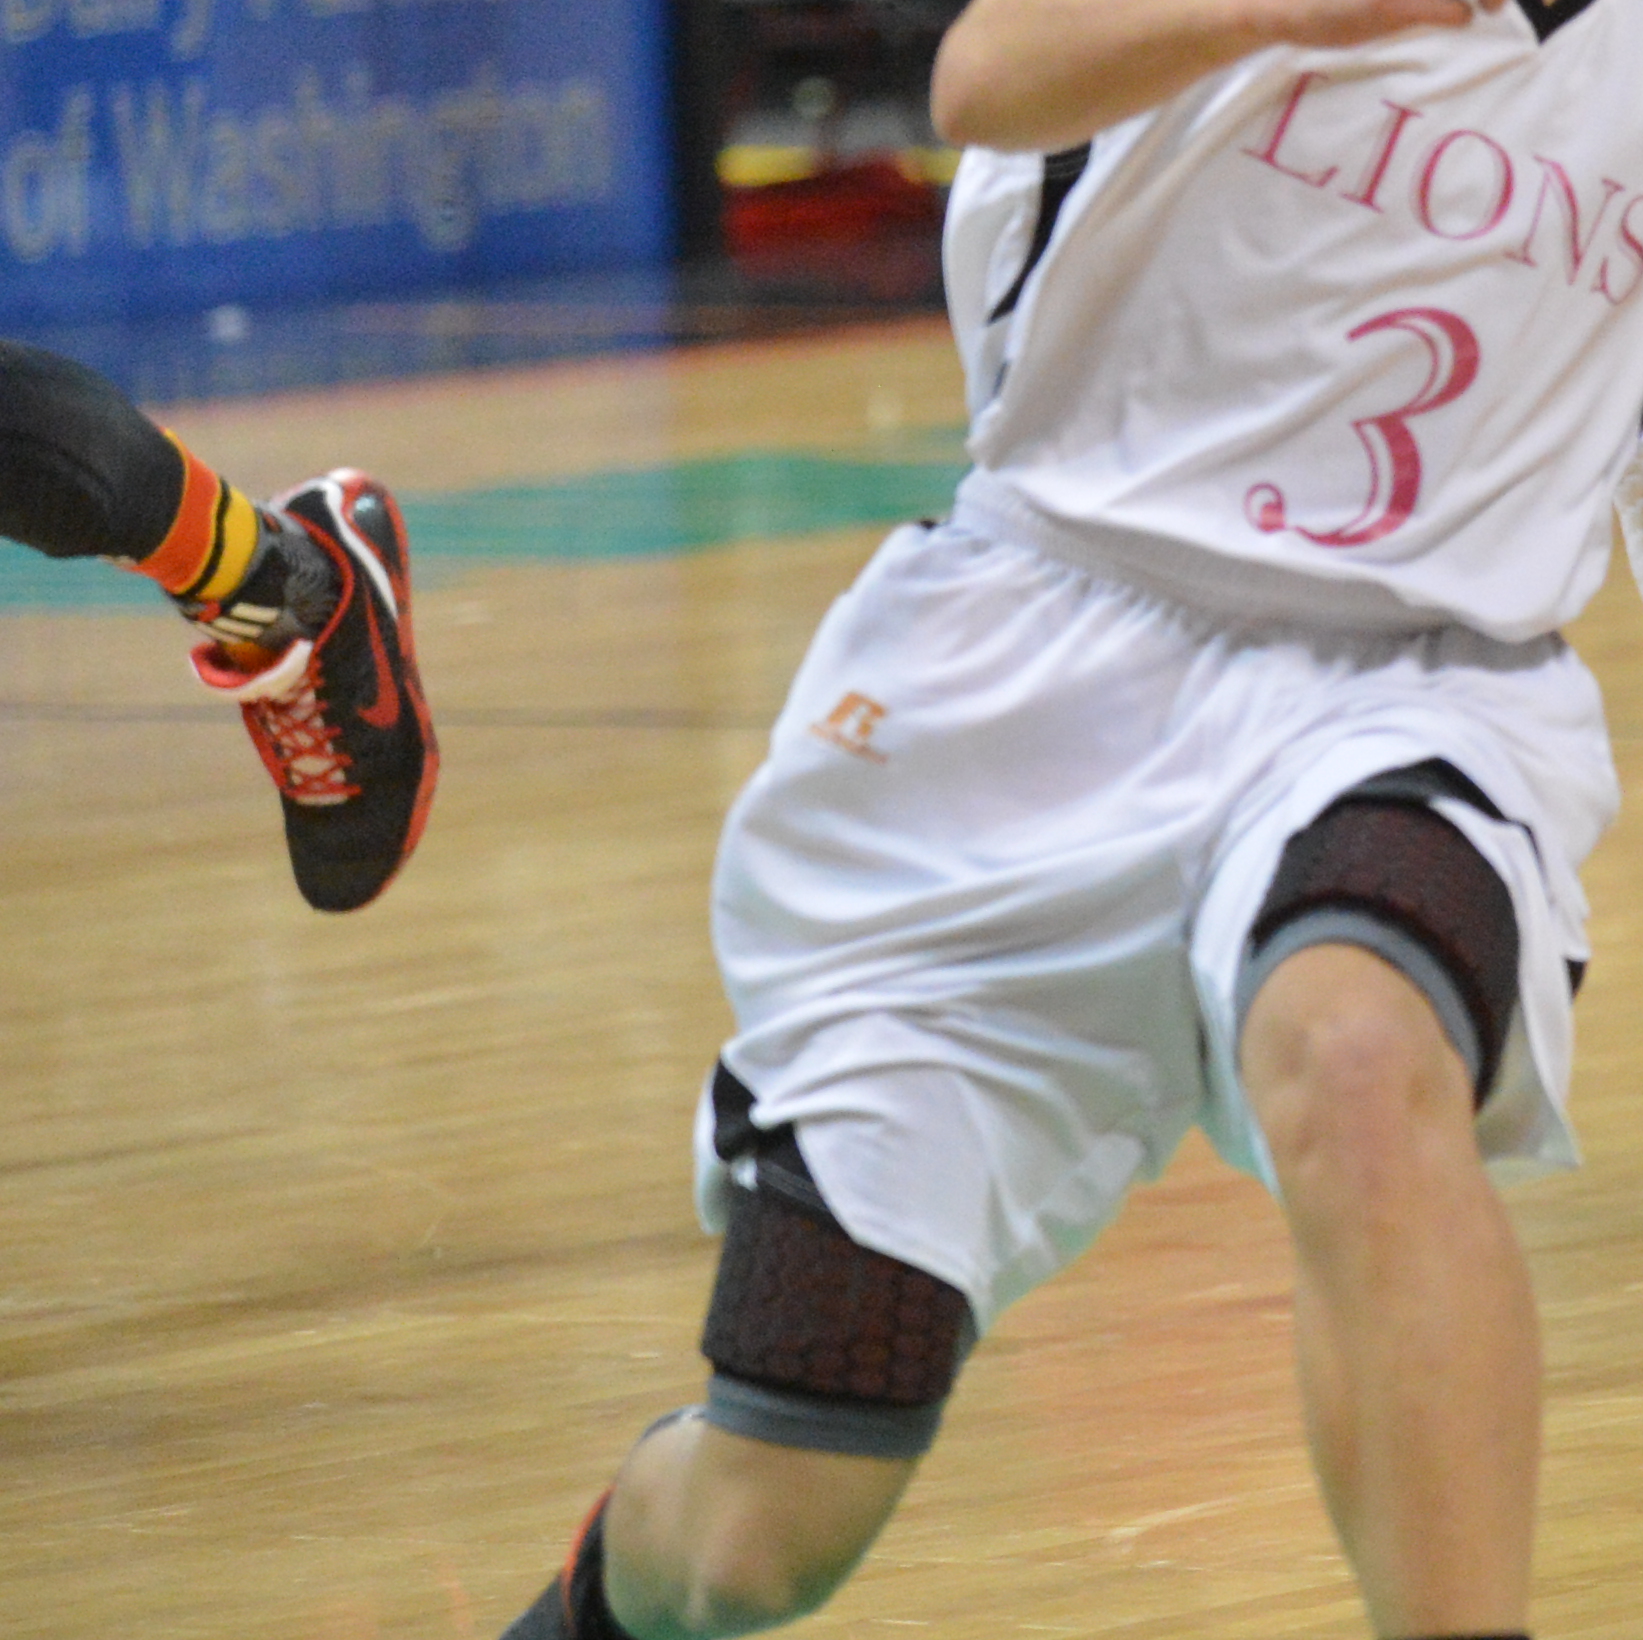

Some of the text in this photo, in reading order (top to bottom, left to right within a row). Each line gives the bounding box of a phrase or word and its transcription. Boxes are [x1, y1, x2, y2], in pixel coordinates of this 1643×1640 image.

[6, 62, 612, 262] of Washington
[1244, 306, 1480, 548] 3
